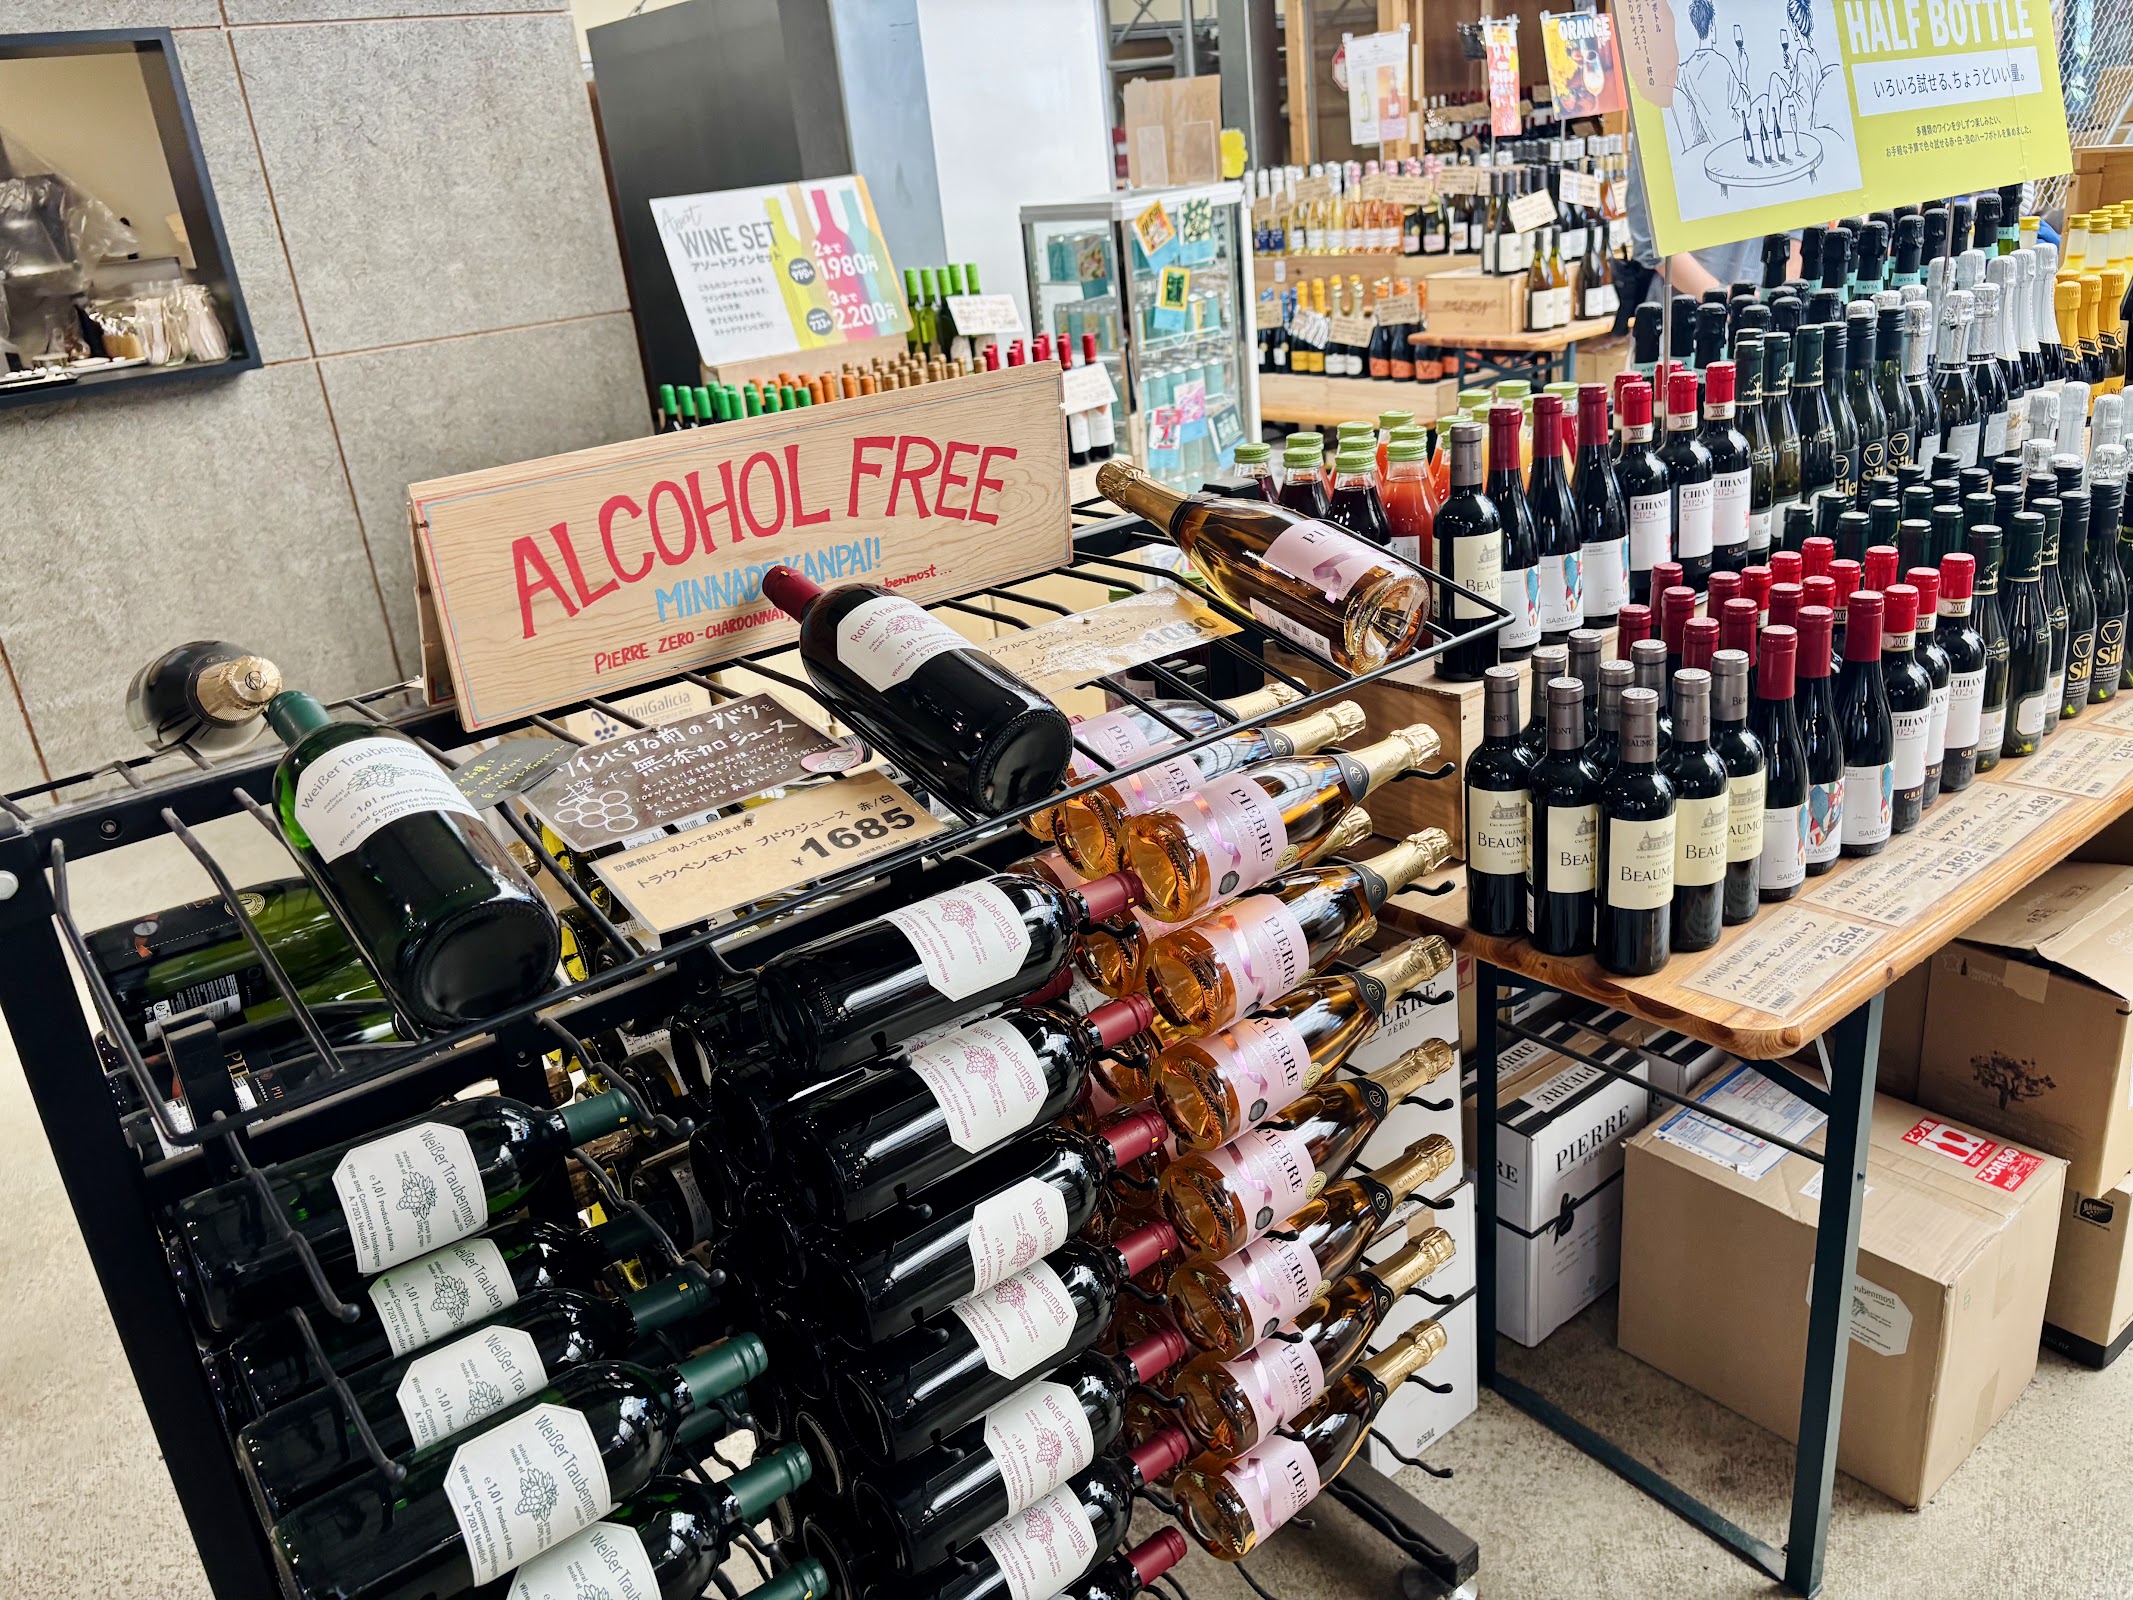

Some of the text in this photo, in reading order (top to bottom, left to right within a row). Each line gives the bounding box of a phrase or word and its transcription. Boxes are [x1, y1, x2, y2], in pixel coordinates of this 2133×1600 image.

[1557, 17, 1611, 41] ORANGE
[1844, 0, 2033, 54] HALF BOTTLE
[1874, 63, 2025, 98] いろいろ試せる、ちょうどいい量。
[1916, 116, 2001, 136] 多種類のワインを少しずつ楽しみたい、
[678, 221, 777, 258] WINE SET
[691, 251, 781, 272] アソートワインセット
[817, 253, 879, 280] 1,980円
[833, 302, 898, 330] 2,200円
[1633, 510, 1656, 520] 2024
[1682, 498, 1704, 508] 2024
[512, 435, 1018, 639] ALCOHOL FREE
[850, 615, 878, 643] Roter
[595, 642, 650, 674] PIERRE
[658, 630, 695, 654] ZERO
[891, 662, 904, 677] Wine
[905, 652, 916, 663] and
[622, 692, 691, 718] ViniGalicia
[1247, 702, 1276, 717] CHAVIN
[1896, 727, 1916, 736] 024
[301, 765, 341, 810] Weißer
[323, 788, 345, 810] natural
[382, 806, 405, 821] 7201
[1230, 787, 1274, 862] PIERRE
[1939, 814, 1982, 843] キアンティ
[1987, 792, 2009, 808] ハーフ
[338, 830, 355, 848] Wine
[356, 816, 371, 829] and
[637, 794, 895, 889] トラウベンモスト ブドウジュース 赤/白
[1477, 832, 1526, 848] BEAUM
[1393, 861, 1421, 883] CHAVIN
[1560, 852, 1596, 867] BEAU
[973, 892, 1022, 950] Traubenmost
[942, 938, 955, 961] Austria
[1264, 915, 1295, 990] PIERRE
[1390, 963, 1418, 984] CHAVIN
[1253, 1016, 1299, 1087] PIERRE
[994, 1037, 1040, 1100] Traubenmost
[1391, 1066, 1419, 1089] CHAVIN
[949, 1067, 977, 1117] Product Austria
[1537, 1065, 1598, 1105] PIERRE
[1554, 1104, 1630, 1174] PIERRE
[394, 1152, 404, 1168] made
[402, 1150, 414, 1172] natural
[1255, 1128, 1303, 1194] PIERRE
[1977, 1148, 2020, 1182] こわれもの
[420, 1130, 477, 1229] Weißer Traubenmost
[1397, 1166, 1424, 1189] CHAVIN
[346, 1164, 373, 1224] Wine and Commerce
[352, 1203, 363, 1223] 7201
[378, 1200, 390, 1224] Product
[1032, 1197, 1050, 1228] Roter
[1269, 1238, 1309, 1303] PIERRE
[1399, 1265, 1424, 1288] CHAVIN
[472, 1264, 502, 1310] Trauben
[1020, 1267, 1070, 1325] Traubenmost
[997, 1324, 1011, 1344] Austria
[484, 1333, 516, 1374] Weißer
[411, 1376, 427, 1405] Wine and
[1281, 1343, 1312, 1410] PIERRE
[1042, 1394, 1065, 1421] Roter
[991, 1424, 1010, 1451] Wine and
[509, 1447, 520, 1464] made
[517, 1442, 532, 1466] natural
[534, 1414, 600, 1522] Weißer Traubenmost
[458, 1464, 492, 1538] Wine and Commerce
[467, 1512, 479, 1537] 7201
[495, 1506, 508, 1534] Product
[1051, 1497, 1090, 1557] Traubenmost
[590, 1531, 623, 1576] Weißer
[1011, 1533, 1036, 1581] Product Austria
[566, 1565, 577, 1581] made
[573, 1560, 588, 1583] natural
